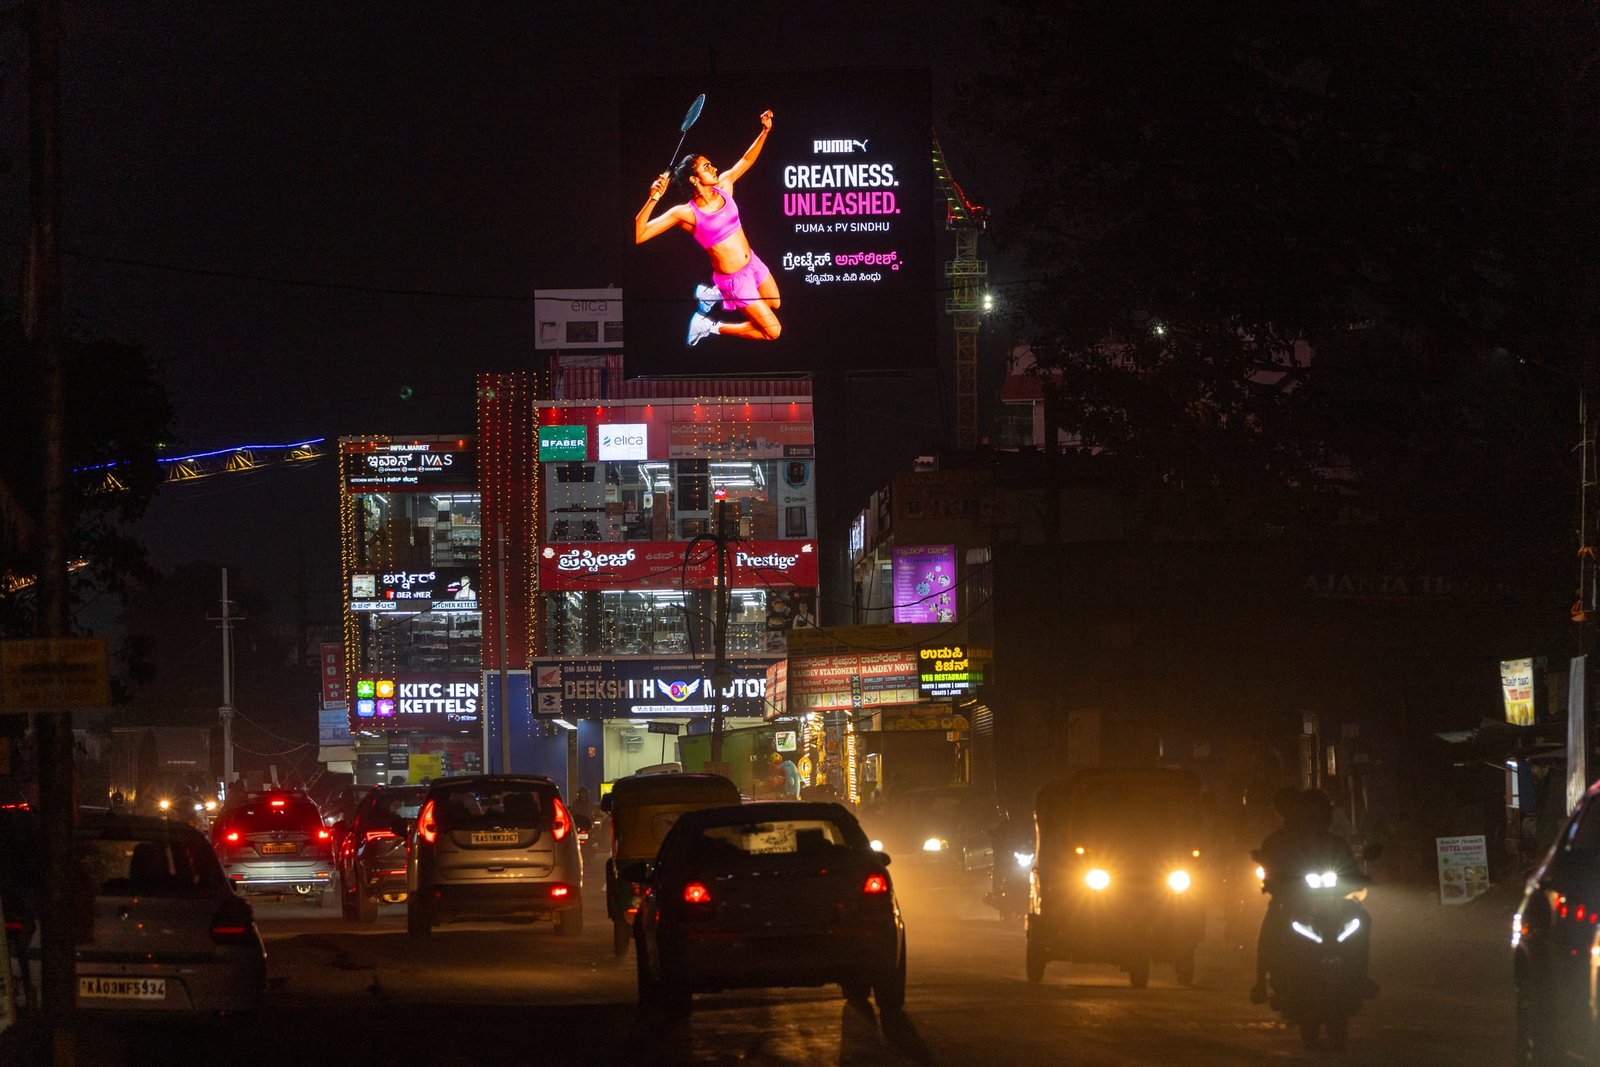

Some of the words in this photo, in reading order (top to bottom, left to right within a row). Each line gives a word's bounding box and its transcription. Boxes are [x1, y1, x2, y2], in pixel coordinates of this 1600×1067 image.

[813, 140, 854, 153] PUMA
[784, 164, 899, 188] GREATNESS.
[783, 192, 900, 216] UNLEASHED.
[795, 223, 825, 232] PUMA
[835, 222, 848, 232] PV
[850, 222, 890, 232] SINDHU
[571, 299, 608, 312] elica
[614, 436, 643, 446] elica
[368, 454, 412, 468] ಇವಾಸ್
[421, 454, 452, 466] IVAS
[736, 552, 796, 570] Prestige
[920, 647, 962, 659] ಉಡುಪಿ
[820, 666, 858, 676] STATIONERY
[862, 664, 893, 674] RAMDEV
[935, 659, 968, 671] ಕಿಚನ್
[564, 679, 655, 699] DEEKSHITH
[853, 676, 861, 707] XEROX
[400, 699, 476, 713] KETTELS
